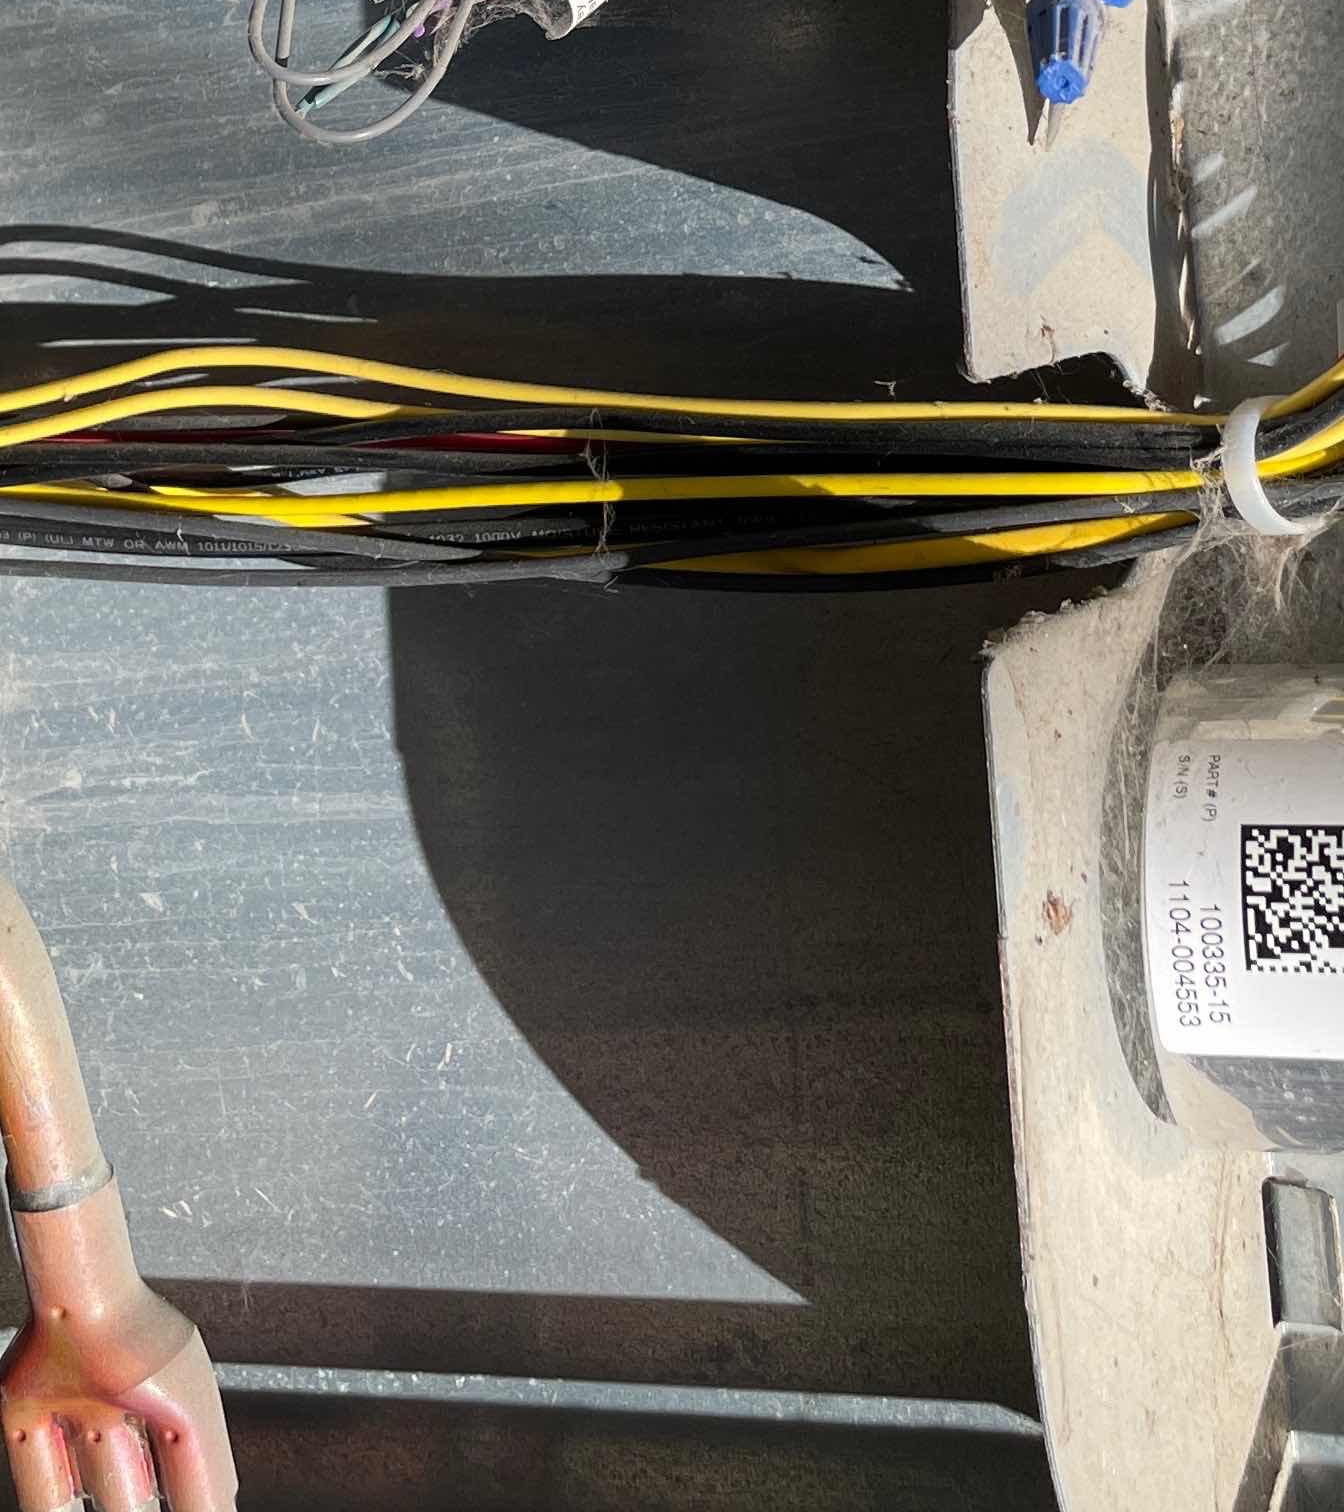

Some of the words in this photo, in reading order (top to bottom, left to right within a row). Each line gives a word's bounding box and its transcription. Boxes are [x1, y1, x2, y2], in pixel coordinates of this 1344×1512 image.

[1176, 754, 1191, 778] S/N
[1206, 754, 1221, 788] PART
[1173, 781, 1189, 800] (S)
[1202, 803, 1218, 823] (P)
[1168, 880, 1202, 1027] 1104-004553
[1199, 904, 1231, 1025] 100335-15
